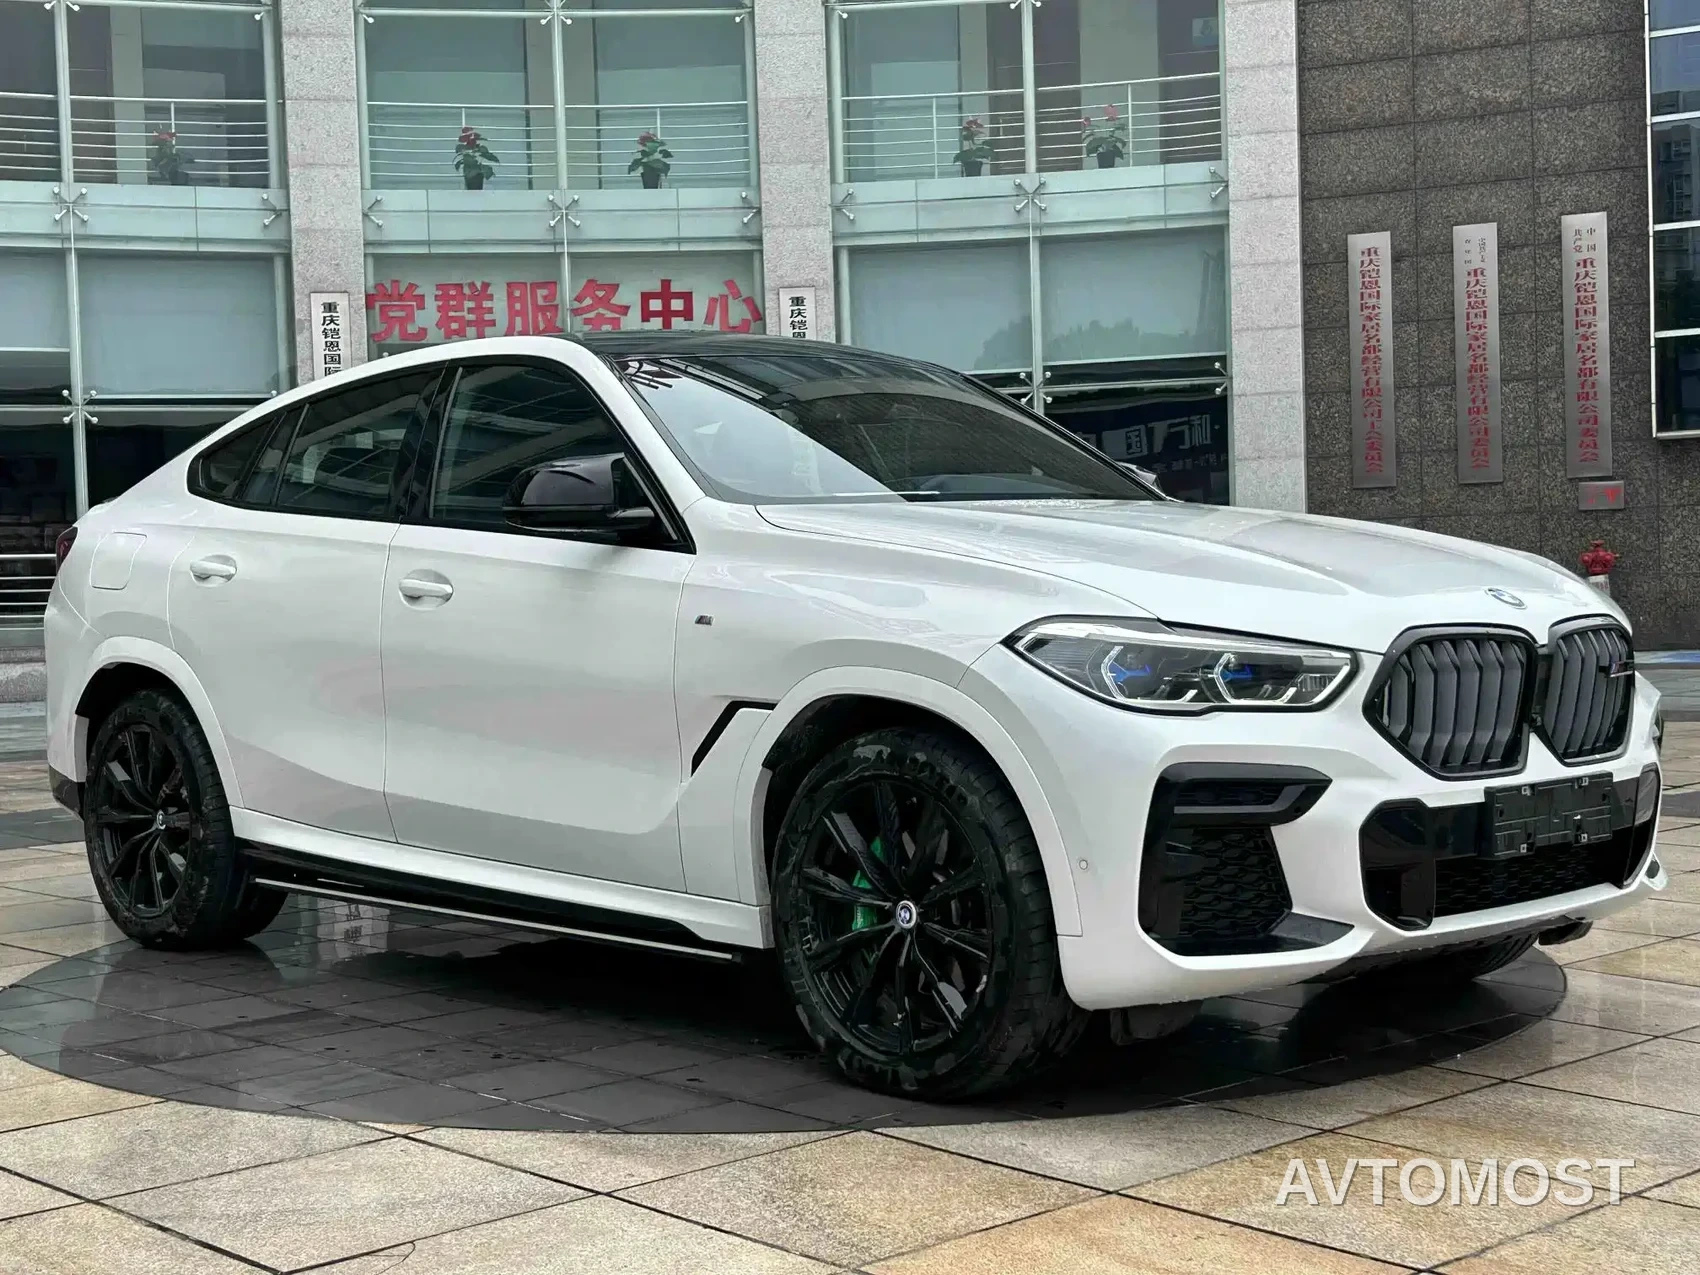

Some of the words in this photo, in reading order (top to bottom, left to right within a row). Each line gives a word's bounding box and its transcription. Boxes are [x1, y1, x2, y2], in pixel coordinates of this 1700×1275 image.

[321, 302, 342, 377] 重庆铠恩国际
[365, 279, 763, 343] 党群服务中心
